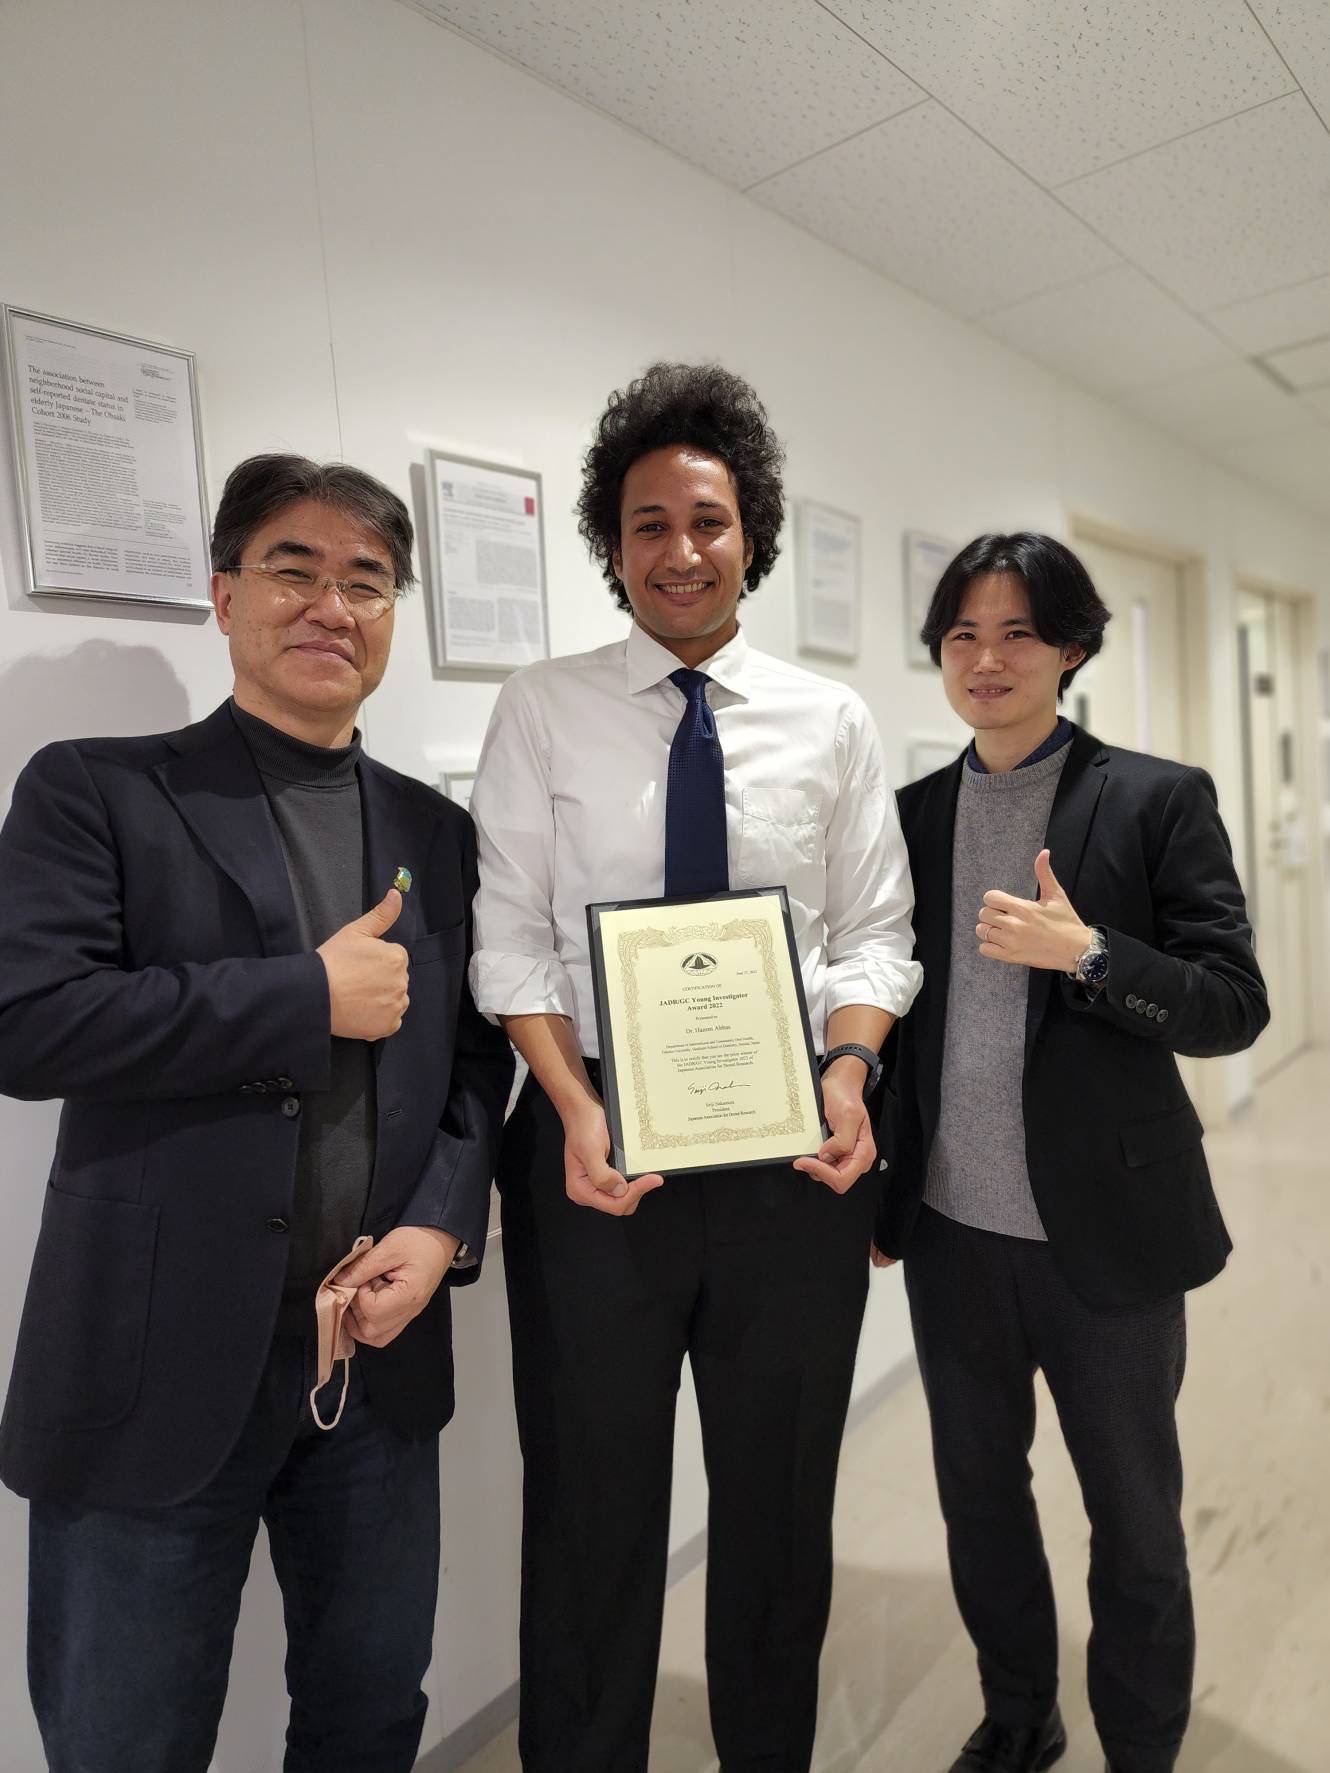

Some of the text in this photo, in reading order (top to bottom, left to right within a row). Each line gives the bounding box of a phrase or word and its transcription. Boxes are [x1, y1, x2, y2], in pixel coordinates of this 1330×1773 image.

[28, 365, 104, 388] The association between
[30, 387, 70, 400] self-reported
[98, 401, 116, 409] status
[76, 386, 93, 396] social
[95, 392, 115, 400] capital
[31, 397, 53, 409] elderly
[56, 401, 82, 412] Japanese
[91, 408, 103, 416] The
[32, 407, 55, 417] Cohort
[73, 414, 90, 426] Study
[660, 998, 690, 1006] JADR/GC
[712, 993, 748, 1001] Investigator
